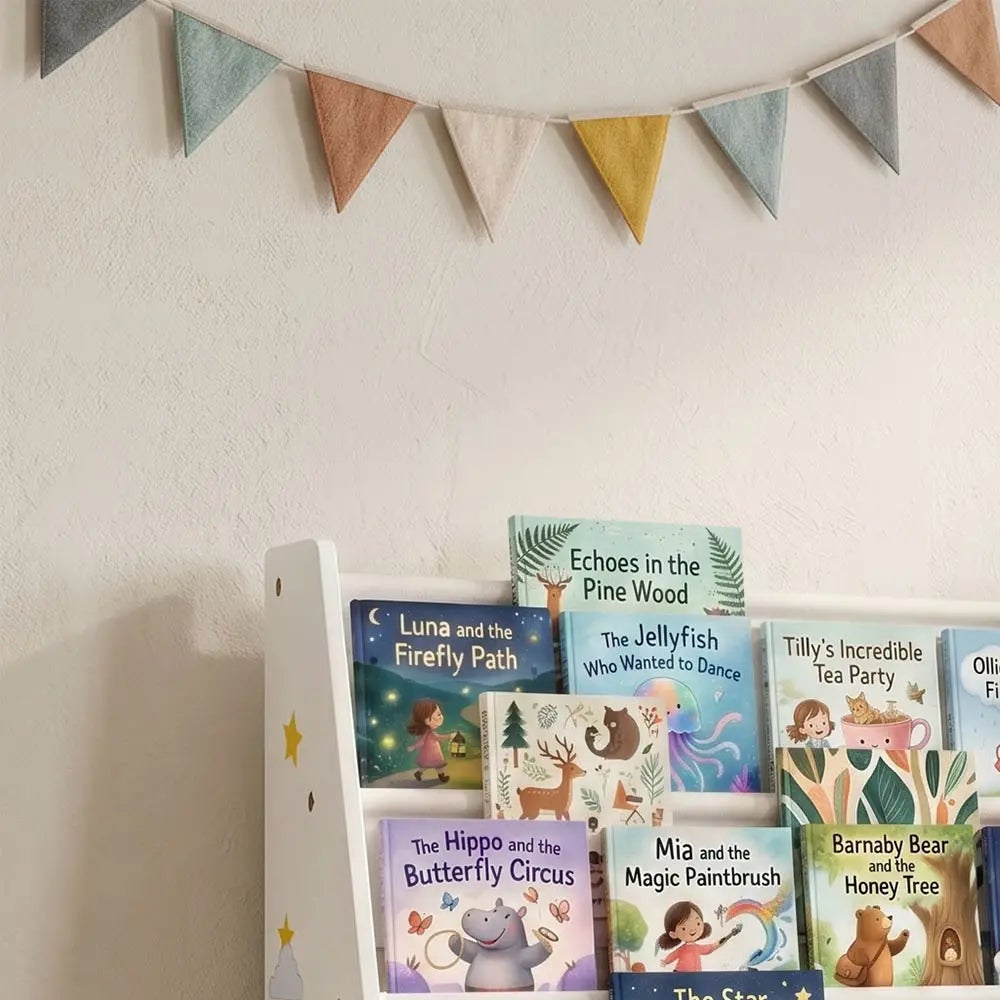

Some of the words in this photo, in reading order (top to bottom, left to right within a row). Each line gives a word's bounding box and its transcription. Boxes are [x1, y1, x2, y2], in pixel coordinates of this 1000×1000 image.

[570, 548, 639, 573] Echoes
[646, 553, 661, 574] in
[668, 554, 701, 576] the
[583, 577, 626, 602] Pine
[632, 581, 689, 604] Wood
[400, 614, 450, 637] Luna
[457, 623, 483, 638] and
[488, 623, 513, 640] the
[601, 631, 628, 649] The
[634, 624, 719, 653] Jellyfish
[395, 643, 464, 676] Firefly
[471, 646, 517, 670] Path
[783, 637, 834, 663] Tilly's
[840, 638, 923, 662] Incredible
[584, 660, 617, 678] Who
[620, 653, 674, 671] Wanted
[679, 656, 693, 672] to
[698, 657, 741, 682] Dance
[815, 664, 843, 684] Tea
[849, 665, 895, 691] Party
[411, 838, 439, 856] The
[444, 830, 503, 856] Hippo
[508, 839, 534, 853] and
[538, 838, 561, 856] the
[656, 837, 693, 861] Mia
[700, 846, 724, 860] and
[727, 845, 750, 861] the
[832, 834, 903, 858] Barnaby
[910, 834, 949, 854] Bear
[404, 857, 501, 887] Butterfly
[510, 858, 575, 885] Circus
[869, 859, 892, 872] and
[895, 859, 915, 872] the
[625, 867, 680, 892] Magic
[685, 867, 781, 887] Paintbrush
[845, 876, 899, 899] Honey
[903, 876, 940, 895] Tree
